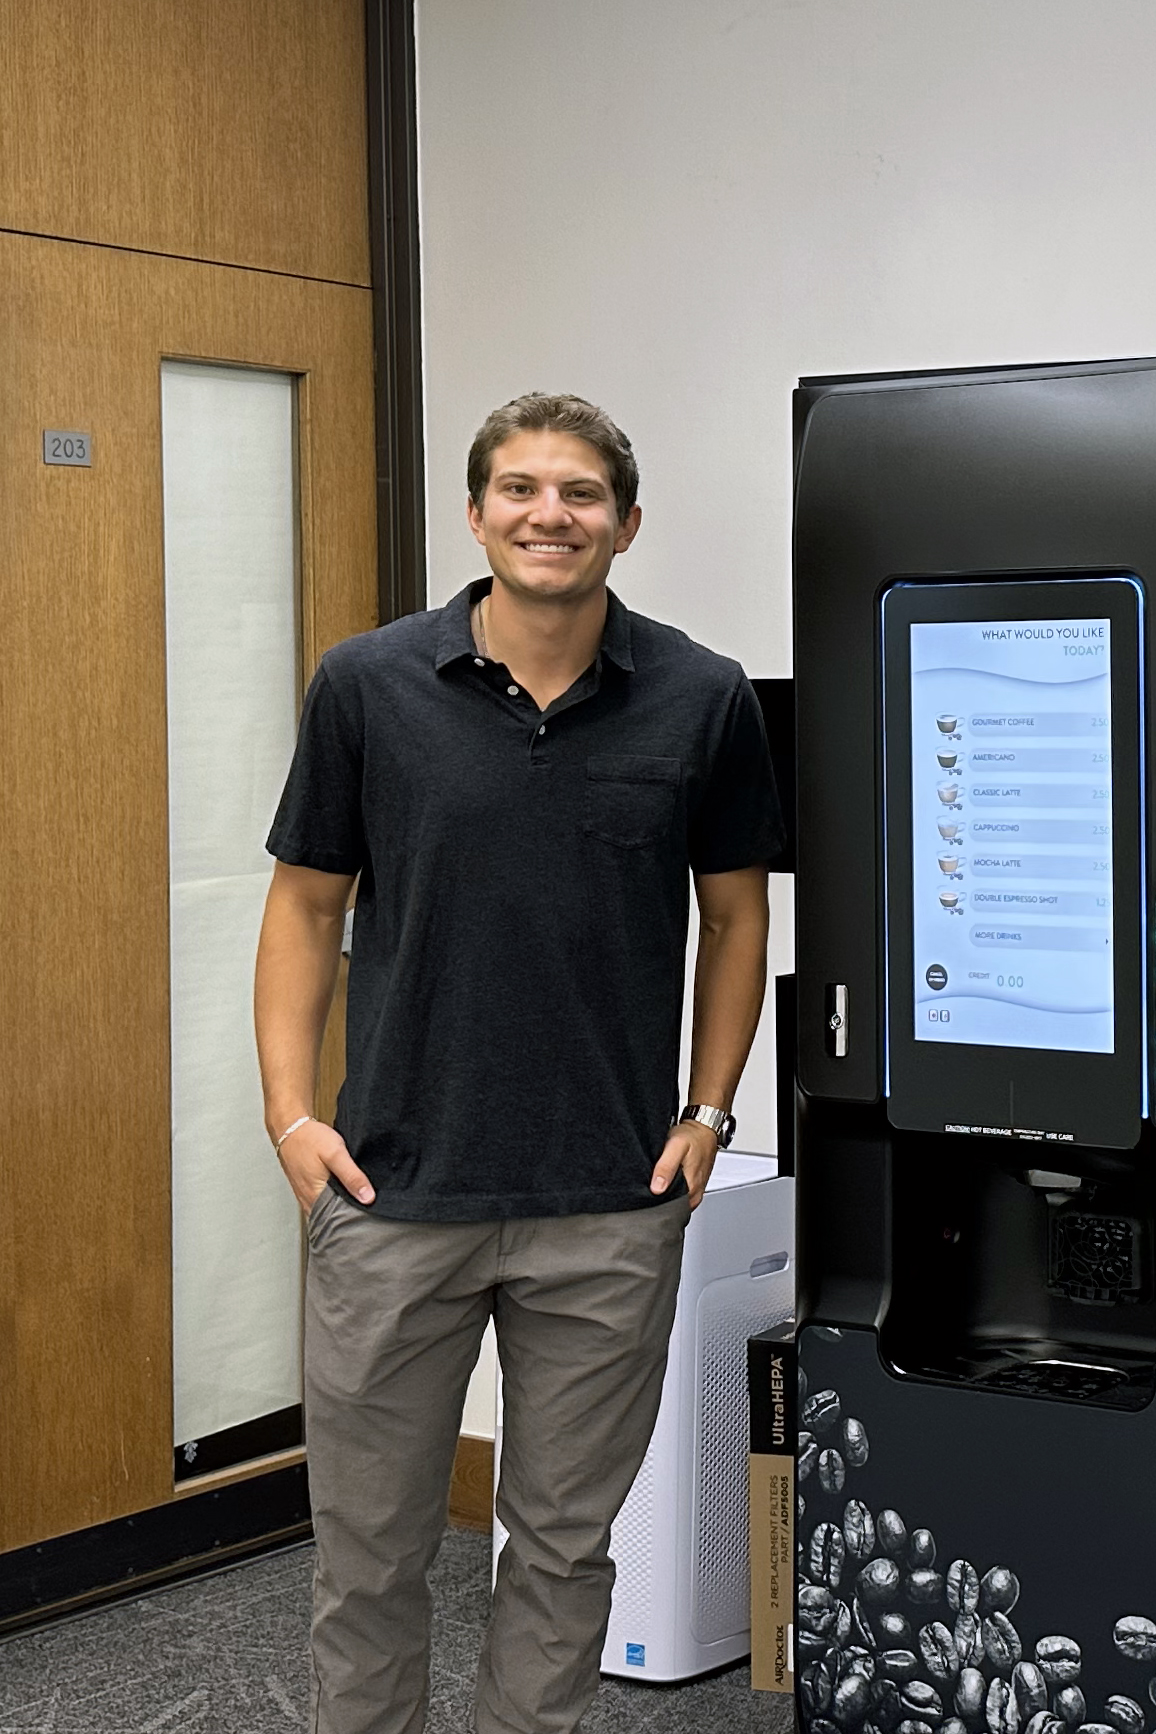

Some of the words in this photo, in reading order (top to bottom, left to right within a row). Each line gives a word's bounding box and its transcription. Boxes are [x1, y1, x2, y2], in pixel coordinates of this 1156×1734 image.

[52, 437, 86, 459] 203
[982, 629, 1013, 640] WHAT
[1015, 629, 1054, 639] WOULD
[1057, 628, 1079, 638] YOU
[1082, 627, 1105, 638] LIKE
[1063, 645, 1105, 656] TODAY?
[972, 718, 1006, 727] GOURMET
[1007, 718, 1035, 727] COFFEE
[972, 753, 1016, 762] AMERICANO
[973, 788, 1000, 797] CLASSIC
[1001, 789, 1021, 797] LATTE
[973, 824, 1020, 832] CAPPUCCINO
[974, 859, 1000, 867] MOCHA
[1002, 859, 1021, 868] LATTE
[974, 894, 1002, 903] DOUBLE
[1004, 895, 1038, 904] ESPRESSO
[1039, 896, 1058, 904] SHOT
[975, 932, 995, 940] MORE
[996, 932, 1022, 941] DRINKS
[968, 972, 990, 980] CREDIT
[997, 975, 1024, 988] 0.00
[1058, 1133, 1074, 1141] CARE
[769, 1474, 779, 1517] FILTERS
[780, 1475, 789, 1526] ADF5005
[781, 1536, 790, 1564] PART
[769, 1518, 779, 1600] REPLACEMENT
[770, 1601, 779, 1609] 2
